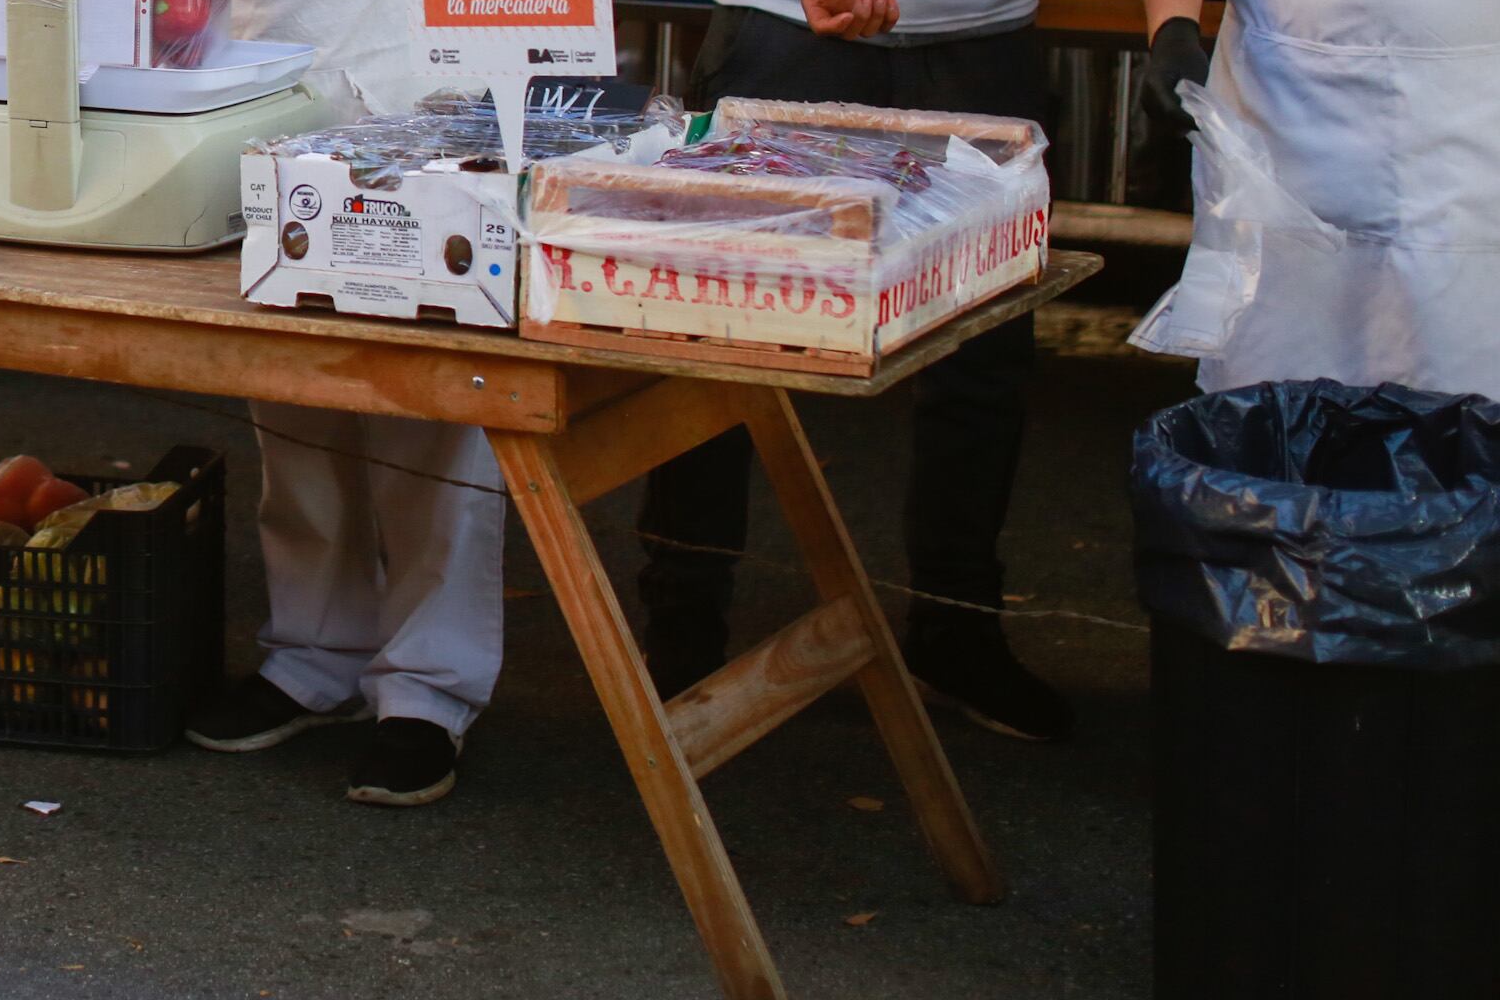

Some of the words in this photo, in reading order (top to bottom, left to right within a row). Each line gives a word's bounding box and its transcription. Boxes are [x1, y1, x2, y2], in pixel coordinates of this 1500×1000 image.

[525, 85, 606, 121] IWI
[250, 183, 266, 192] CAT
[244, 206, 273, 214] PRODUCT
[255, 213, 272, 221] CHILE
[332, 215, 357, 225] KIWI
[361, 217, 419, 229] HAYWARD
[485, 223, 505, 235] 25
[877, 226, 971, 327] ROBERTO
[975, 209, 1046, 277] CARLOS
[601, 252, 857, 319] CARLOS
